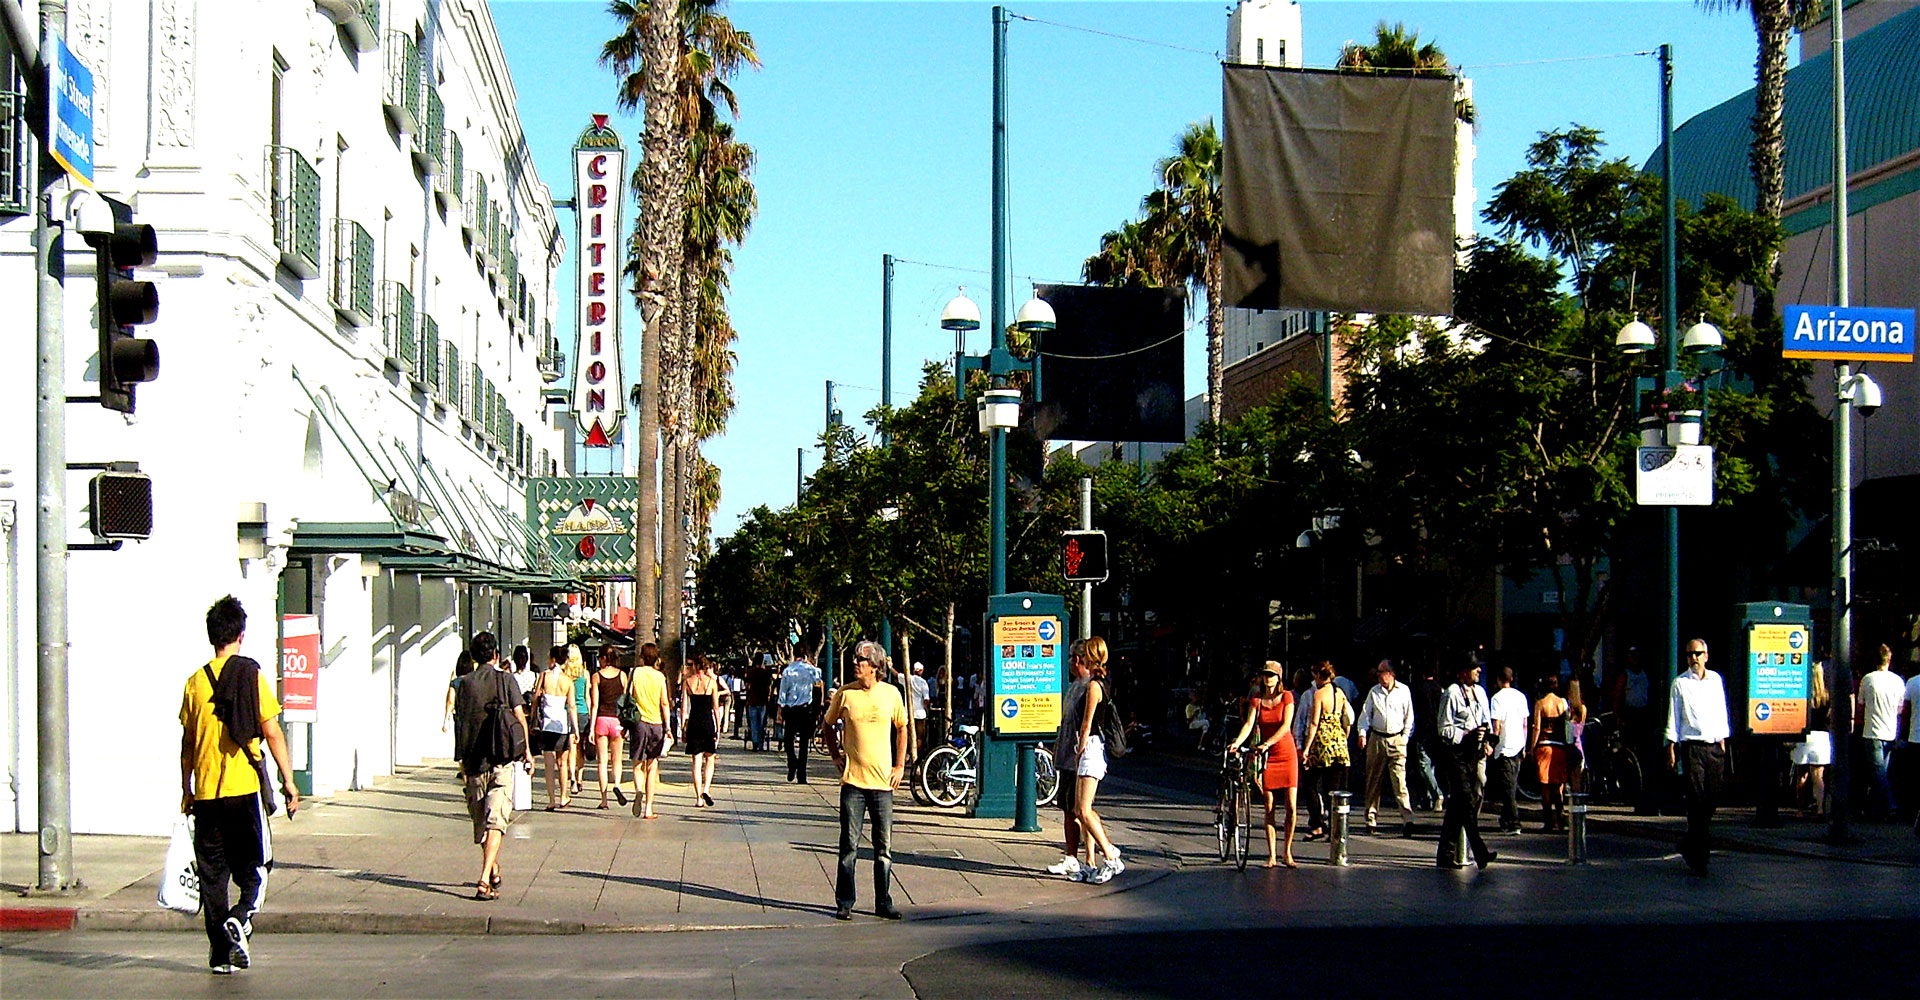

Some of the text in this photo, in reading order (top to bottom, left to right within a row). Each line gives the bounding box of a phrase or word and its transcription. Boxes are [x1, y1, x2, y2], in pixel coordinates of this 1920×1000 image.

[68, 75, 91, 120] Street
[588, 154, 607, 411] CRITERION
[1793, 311, 1904, 344] Arizona
[579, 535, 597, 558] 6
[532, 606, 554, 617] ATM
[1002, 660, 1026, 670] LOOK!
